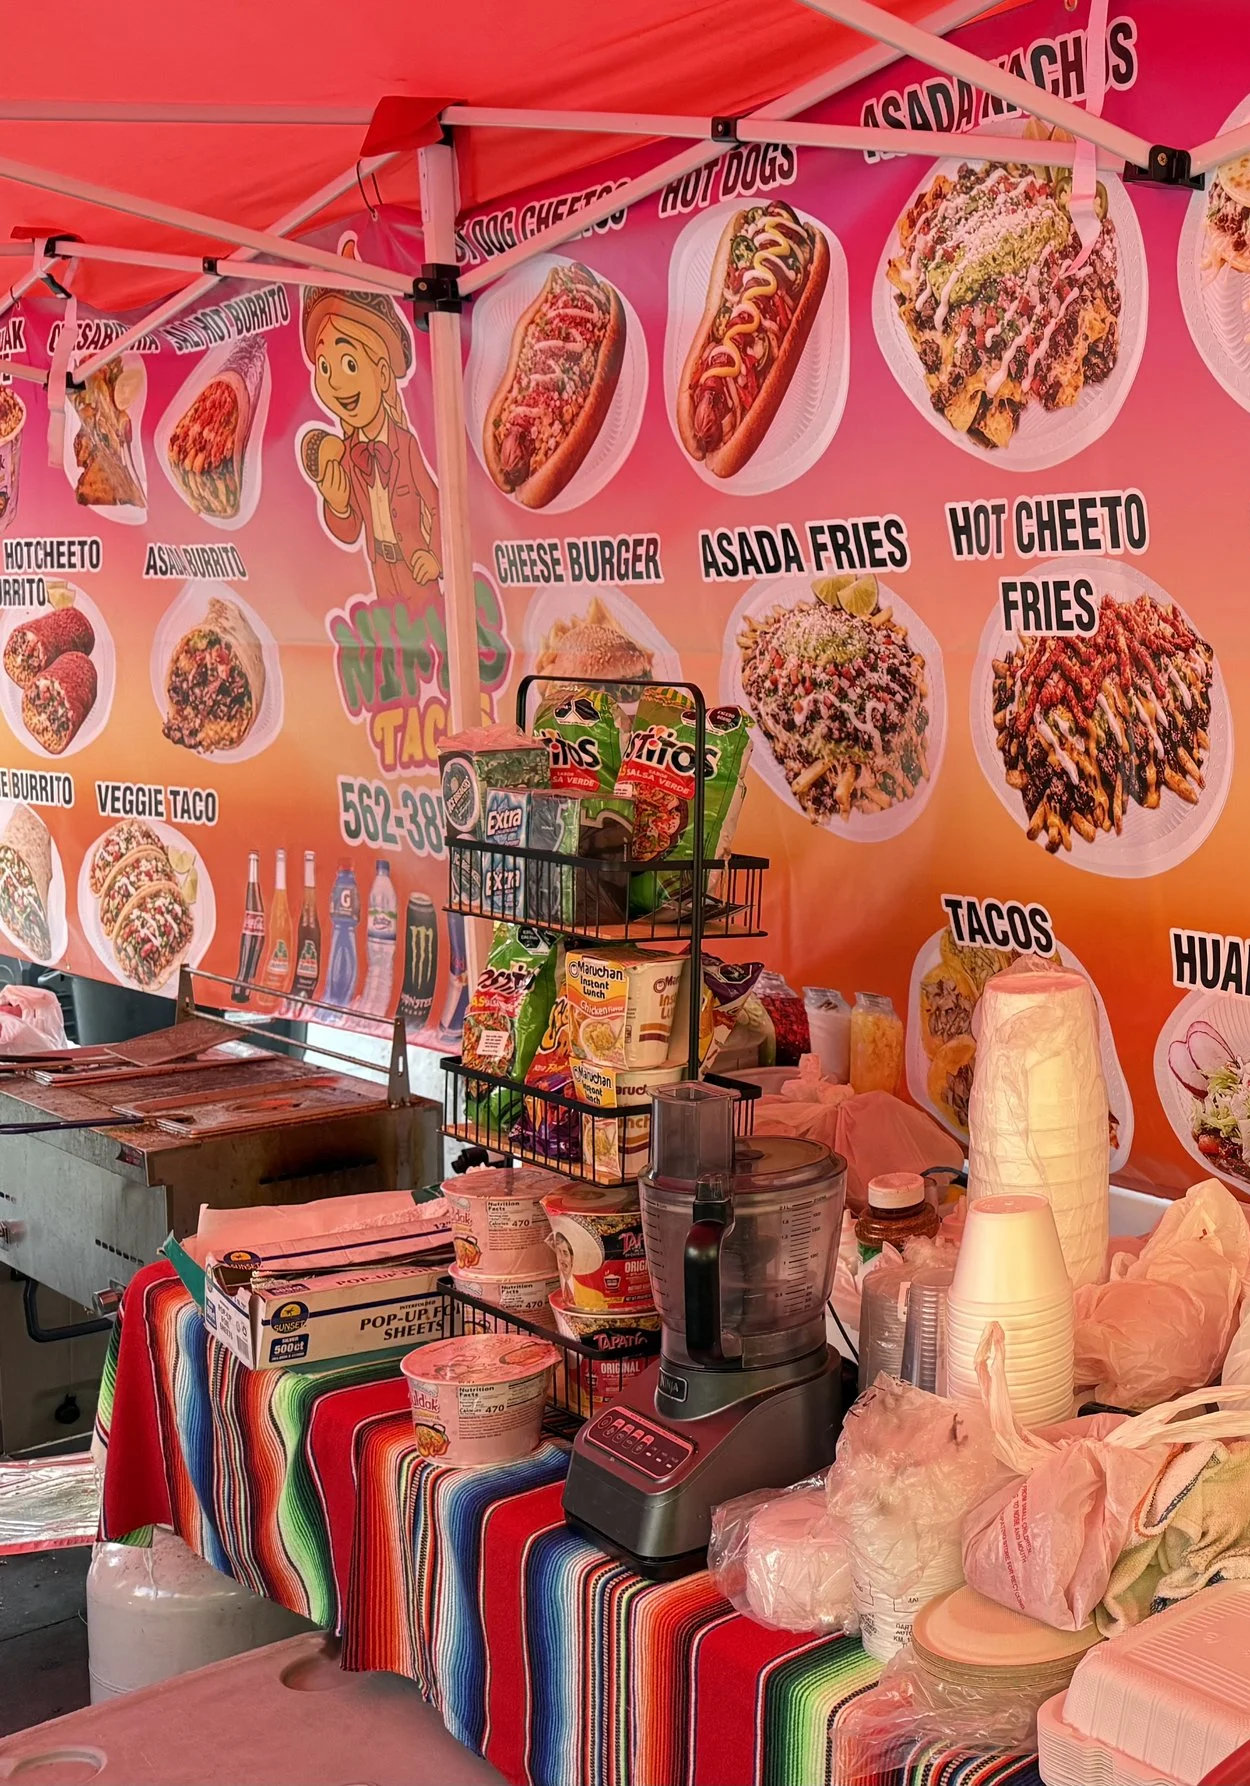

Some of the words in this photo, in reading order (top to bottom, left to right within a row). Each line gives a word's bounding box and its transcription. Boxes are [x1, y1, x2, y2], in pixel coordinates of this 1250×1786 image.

[863, 82, 973, 158] ASADA
[982, 22, 1134, 119] NACHS
[661, 156, 719, 213] HOT
[722, 143, 796, 196] DOGS
[225, 285, 288, 336] BURRITO
[947, 502, 1007, 556] HOT
[1017, 493, 1147, 551] CHEETO
[184, 546, 247, 578] BURRITO
[495, 543, 564, 583] CHEESE
[568, 538, 661, 581] BURGER
[702, 527, 802, 577] ASADA
[810, 519, 907, 571] FRIES
[1001, 579, 1096, 632] FRIES
[12, 771, 72, 806] BURRITO
[567, 777, 594, 788] VERDE
[627, 768, 655, 783] SALSA
[659, 777, 690, 795] VERDE
[97, 783, 165, 818] VEGGIE
[169, 789, 217, 823] TACO
[486, 807, 523, 837] Extra
[944, 898, 1054, 953] TACOS
[578, 960, 624, 981] Maruchan
[581, 975, 610, 990] Instant
[580, 1000, 608, 1015] Chicken
[583, 987, 606, 1000] Lunch
[525, 1301, 543, 1309] 470
[273, 1320, 305, 1333] SUNSET
[360, 1308, 427, 1331] POP-UP
[383, 1319, 443, 1341] SHEETS
[601, 1362, 641, 1375] ORIGNAL
[485, 1404, 505, 1413] 470
